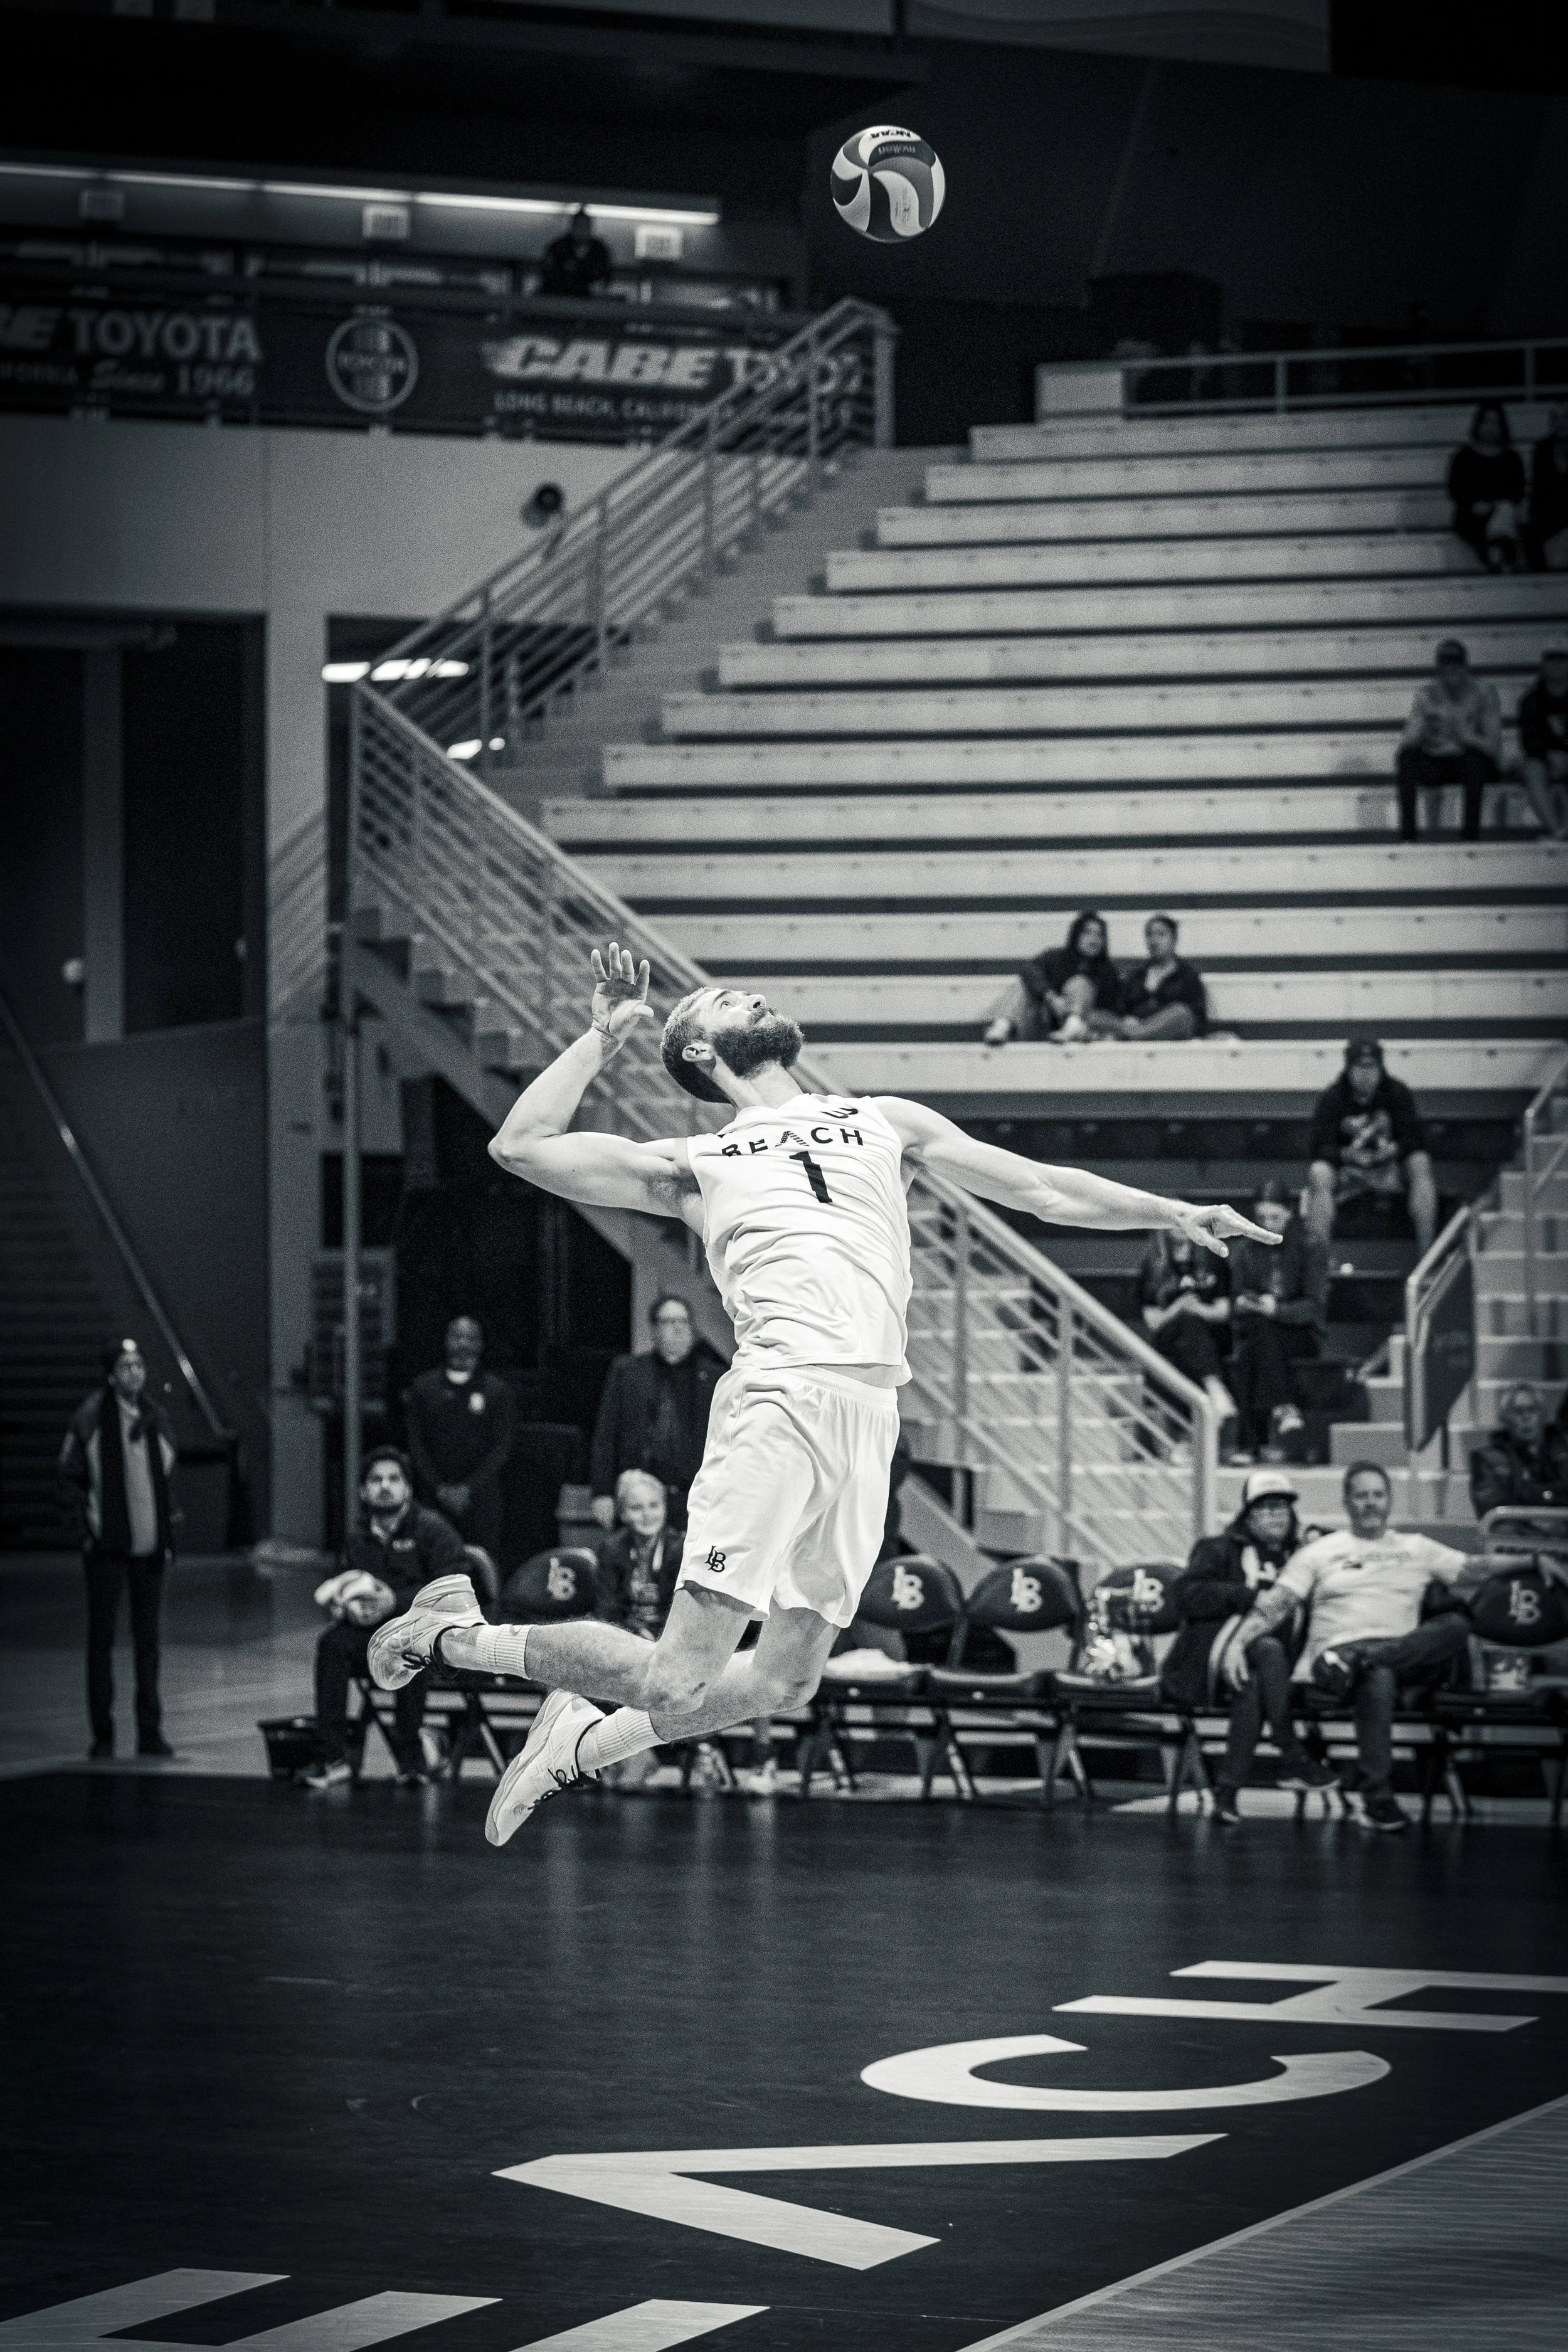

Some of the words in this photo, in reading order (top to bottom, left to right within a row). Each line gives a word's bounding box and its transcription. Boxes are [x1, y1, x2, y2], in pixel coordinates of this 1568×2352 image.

[68, 309, 261, 362] TOYOTA
[492, 336, 718, 388] CABE
[721, 1127, 864, 1158] BEACH
[789, 1150, 833, 1204] 1
[704, 1545, 726, 1573] LB
